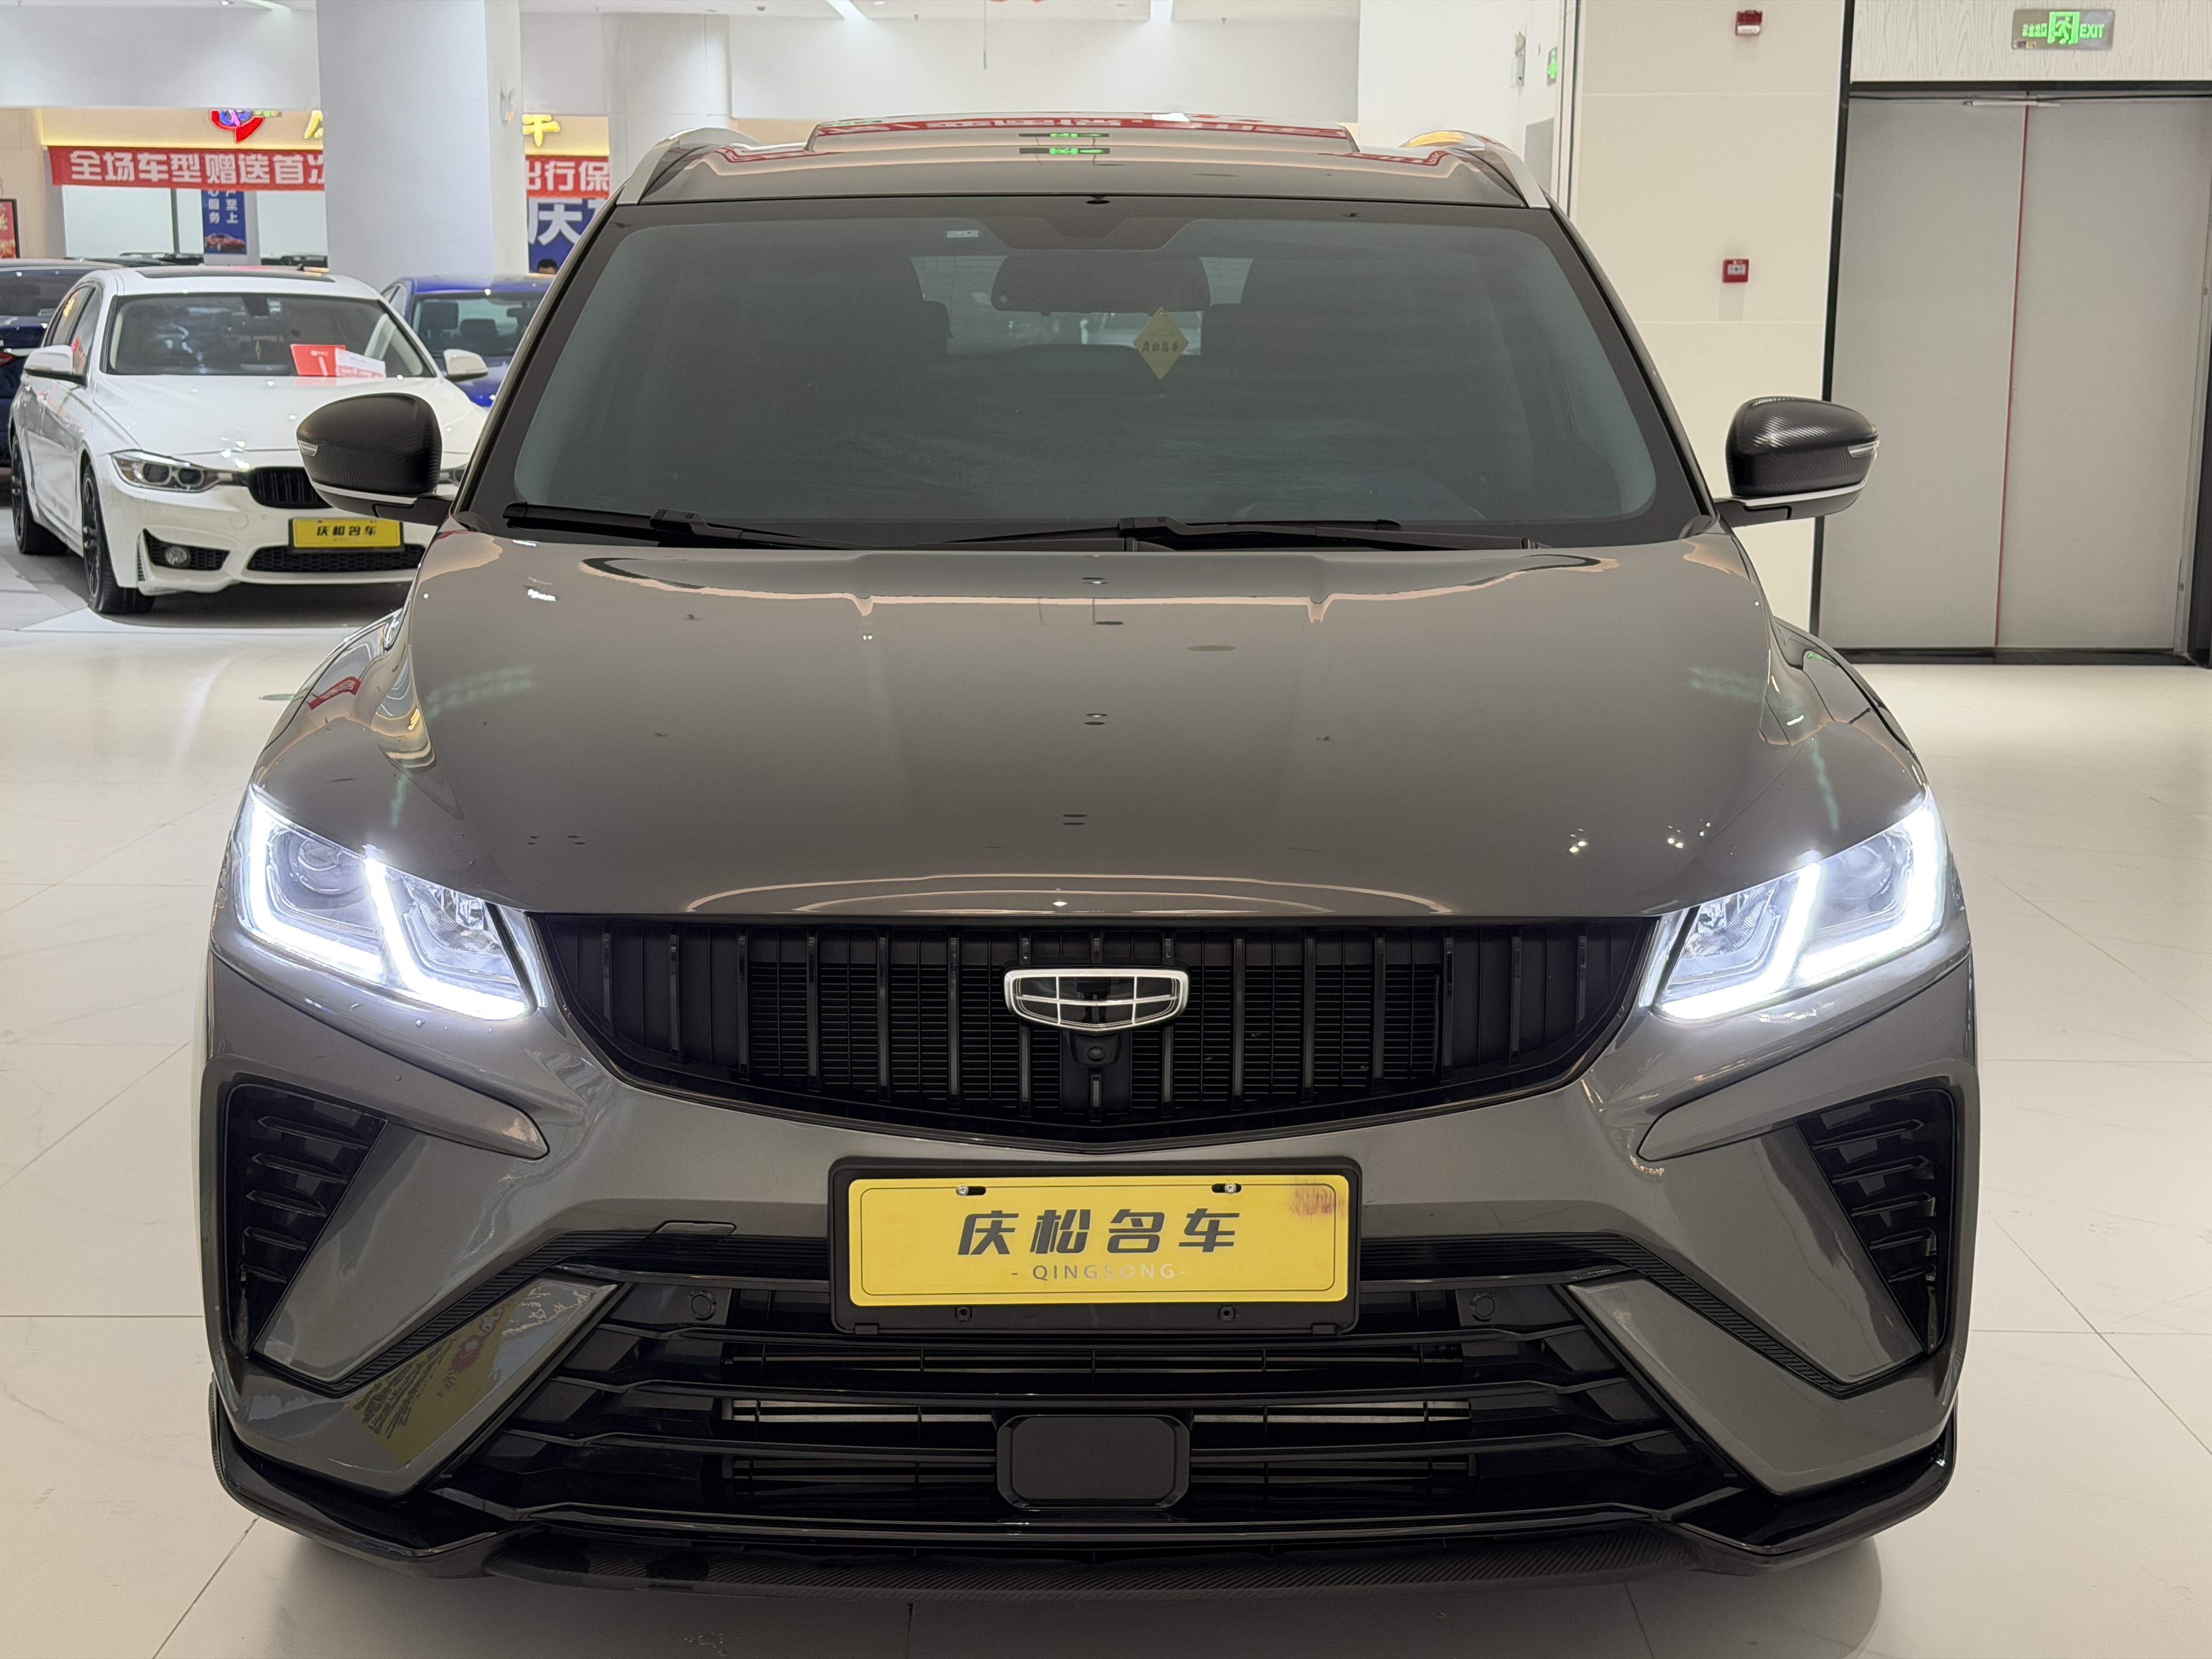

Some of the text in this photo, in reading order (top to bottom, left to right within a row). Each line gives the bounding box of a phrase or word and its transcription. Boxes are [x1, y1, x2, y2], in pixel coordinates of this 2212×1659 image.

[2079, 24, 2104, 38] EXIT
[957, 1208, 1240, 1255] 庆松名车
